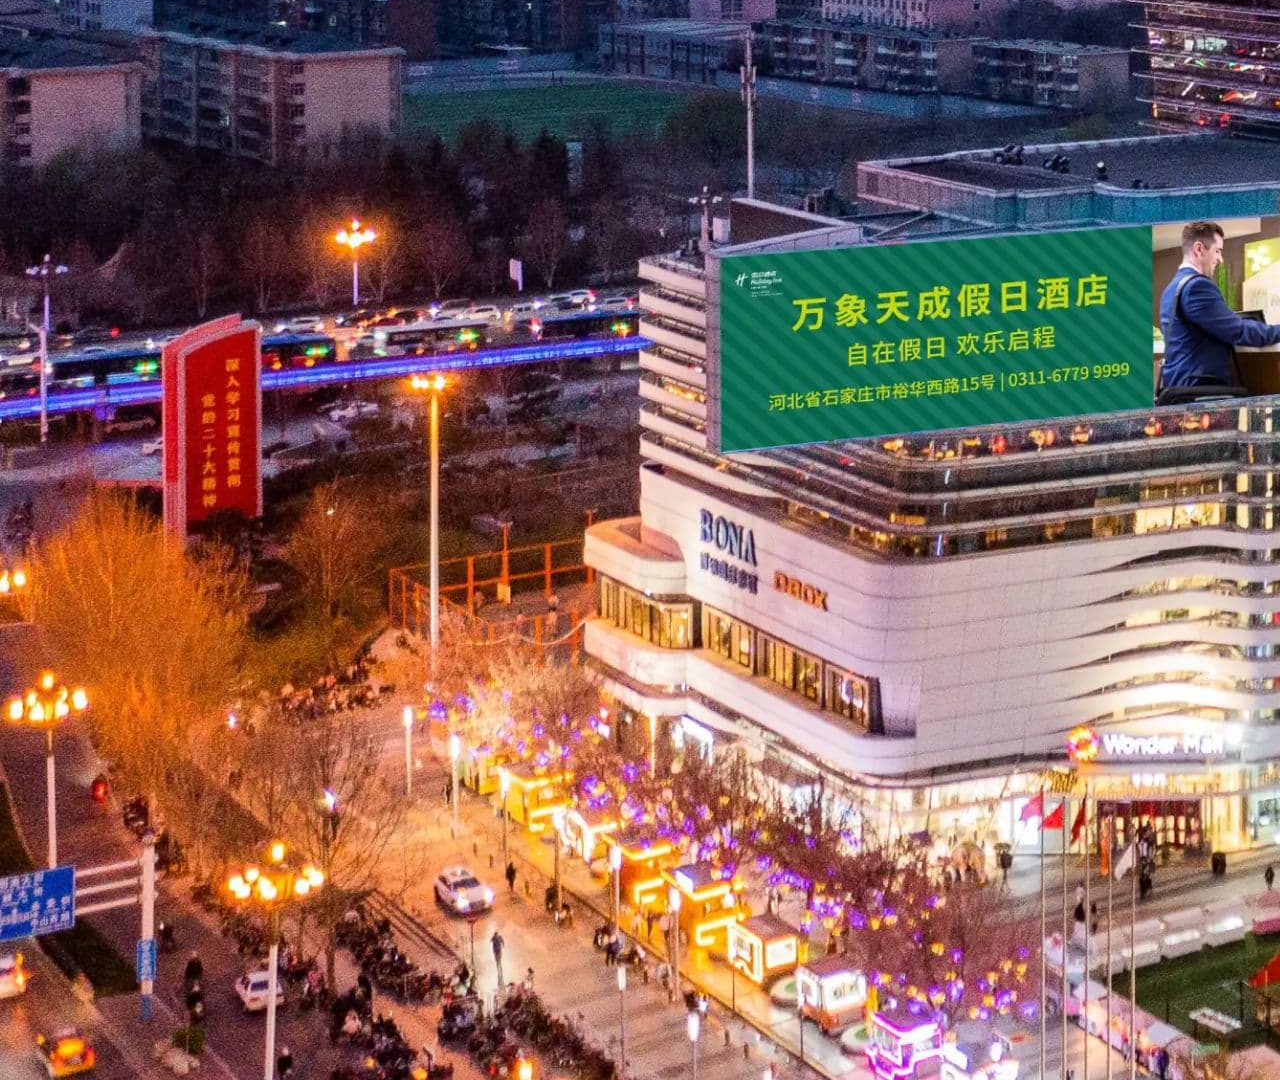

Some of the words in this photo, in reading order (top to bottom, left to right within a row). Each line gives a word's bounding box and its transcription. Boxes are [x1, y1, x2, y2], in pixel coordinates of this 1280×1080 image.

[791, 273, 1109, 332] 万象天成假日酒店
[847, 337, 947, 368] 自在假日
[956, 325, 1056, 357] 欢乐启程
[1008, 366, 1090, 389] 0311-6779
[1093, 361, 1130, 379] 9999
[700, 507, 758, 568] BONA
[1102, 732, 1178, 756] Wonder
[1182, 732, 1224, 756] Mall
